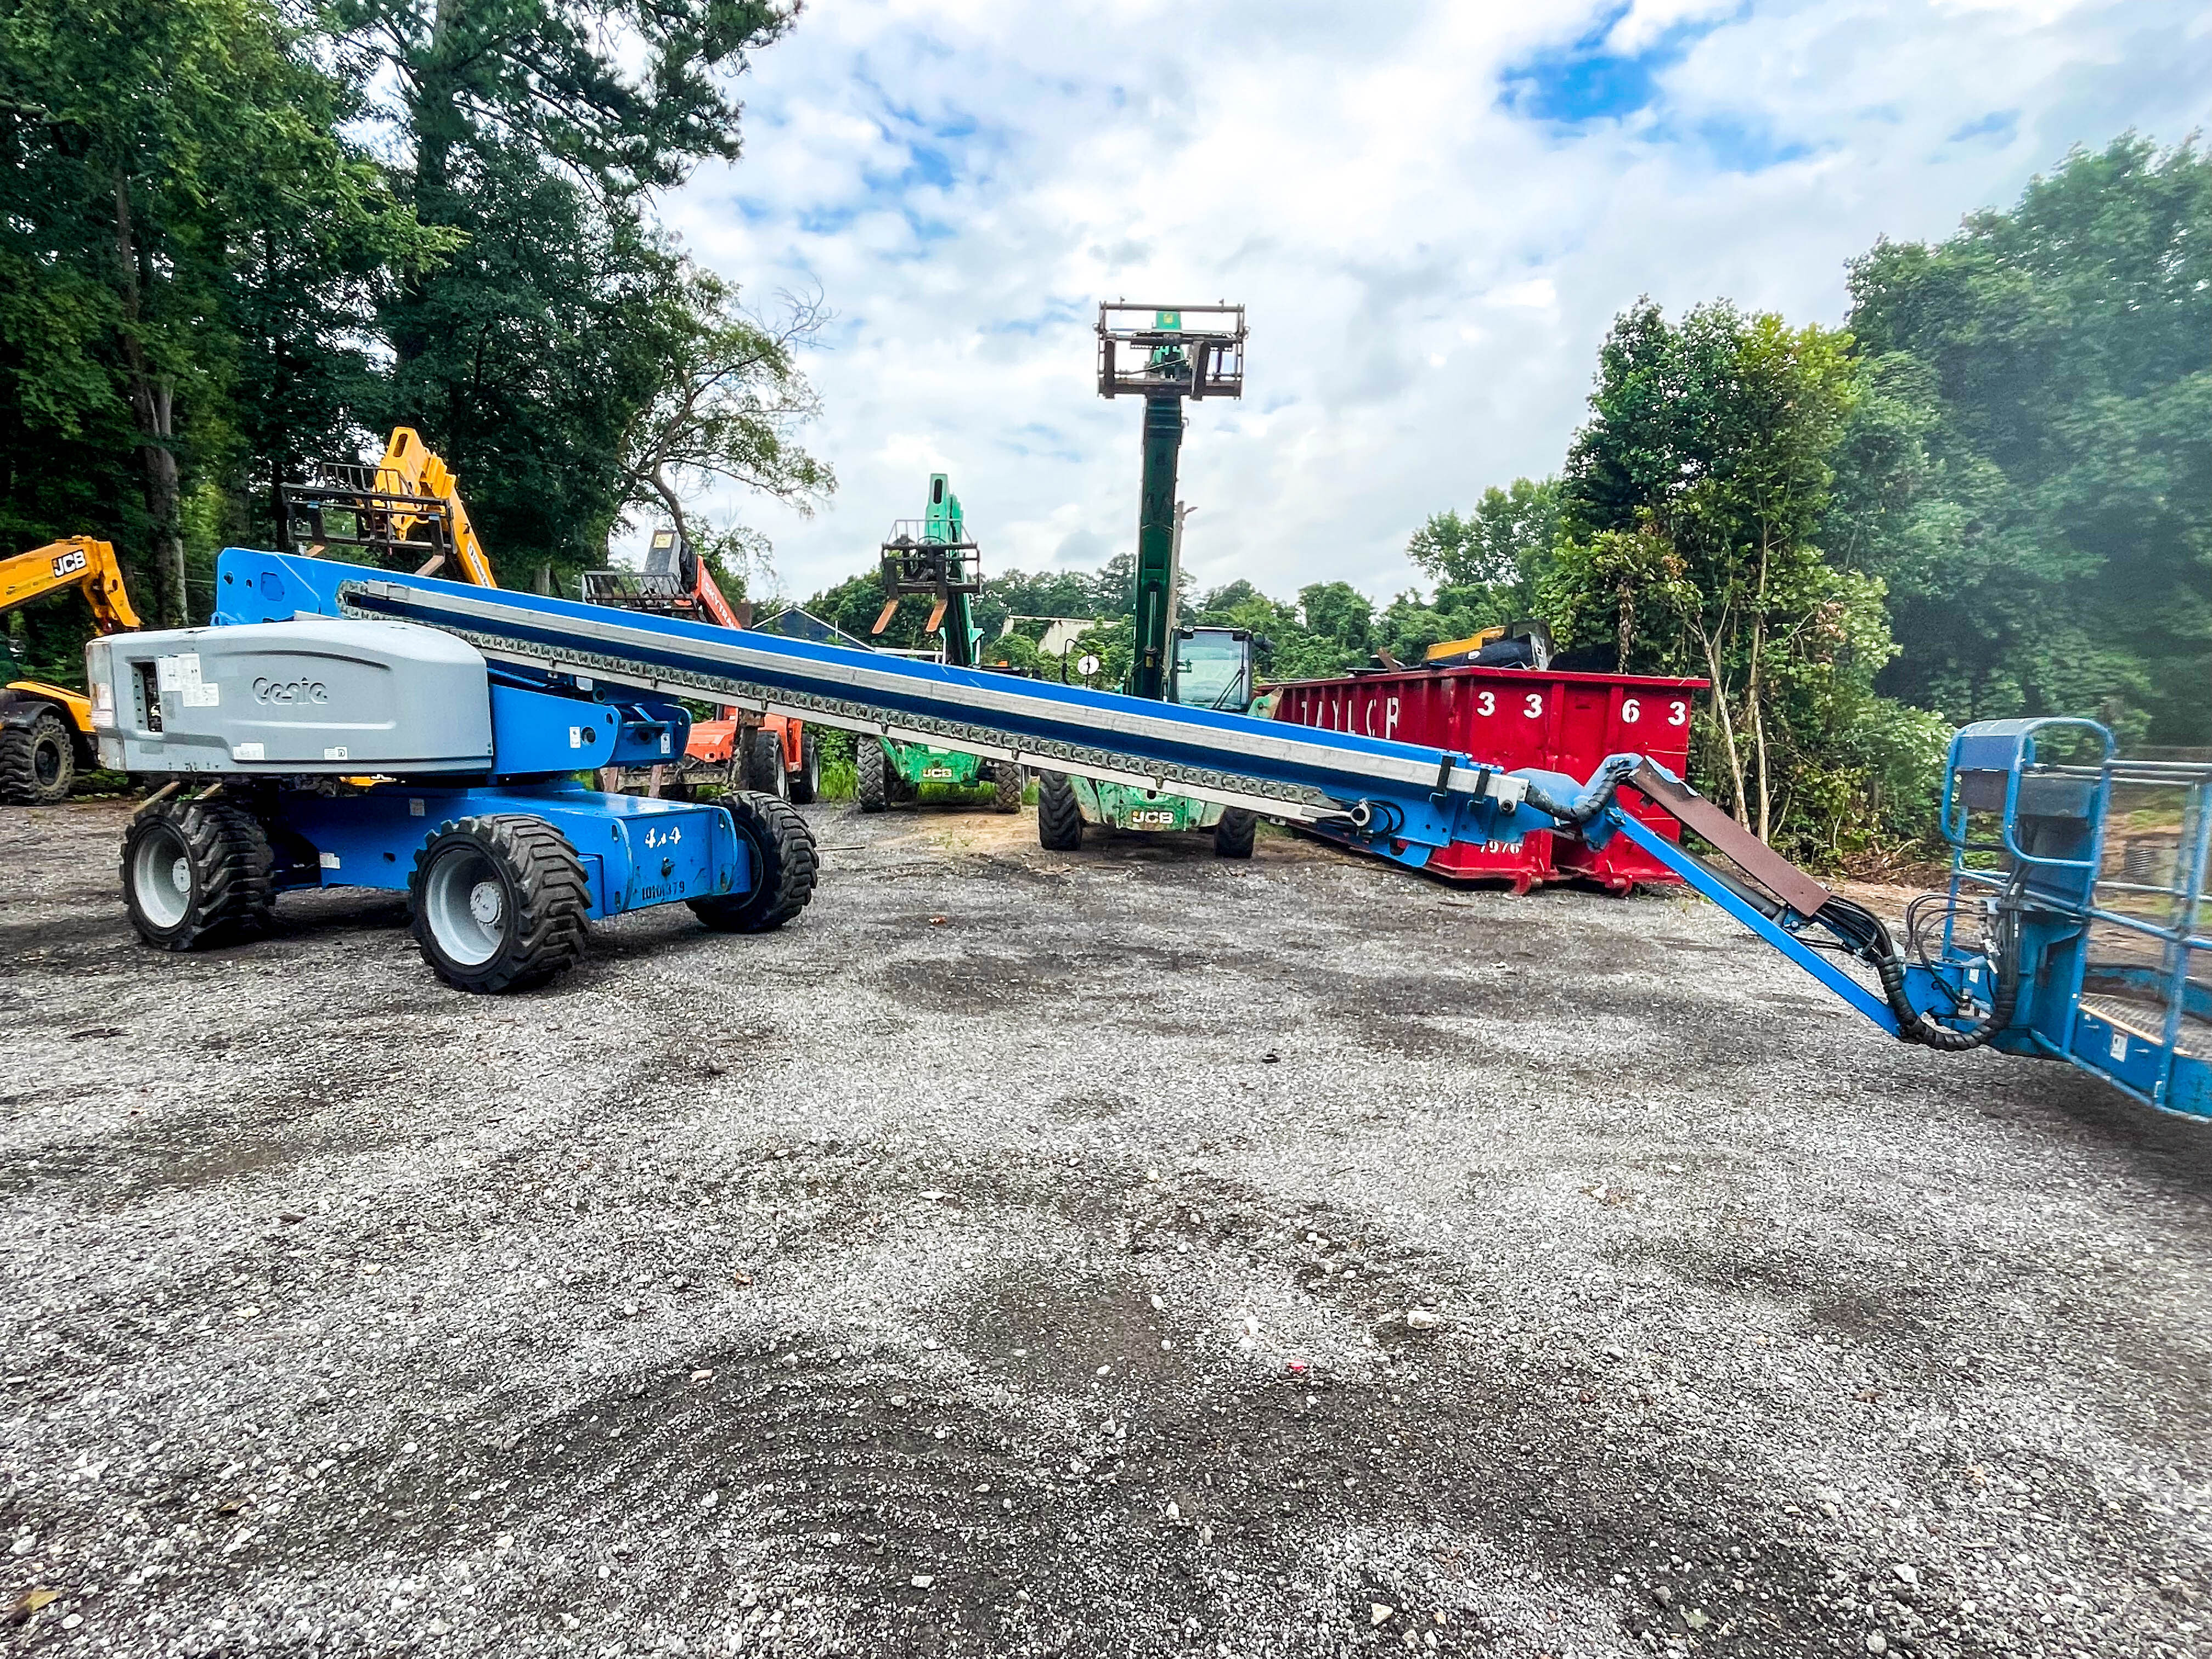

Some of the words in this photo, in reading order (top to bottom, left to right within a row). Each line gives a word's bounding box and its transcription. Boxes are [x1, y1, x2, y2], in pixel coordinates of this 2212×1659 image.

[53, 551, 87, 577] JCB
[252, 677, 329, 706] Genie
[923, 769, 952, 777] JCB
[1132, 811, 1174, 824] JCB
